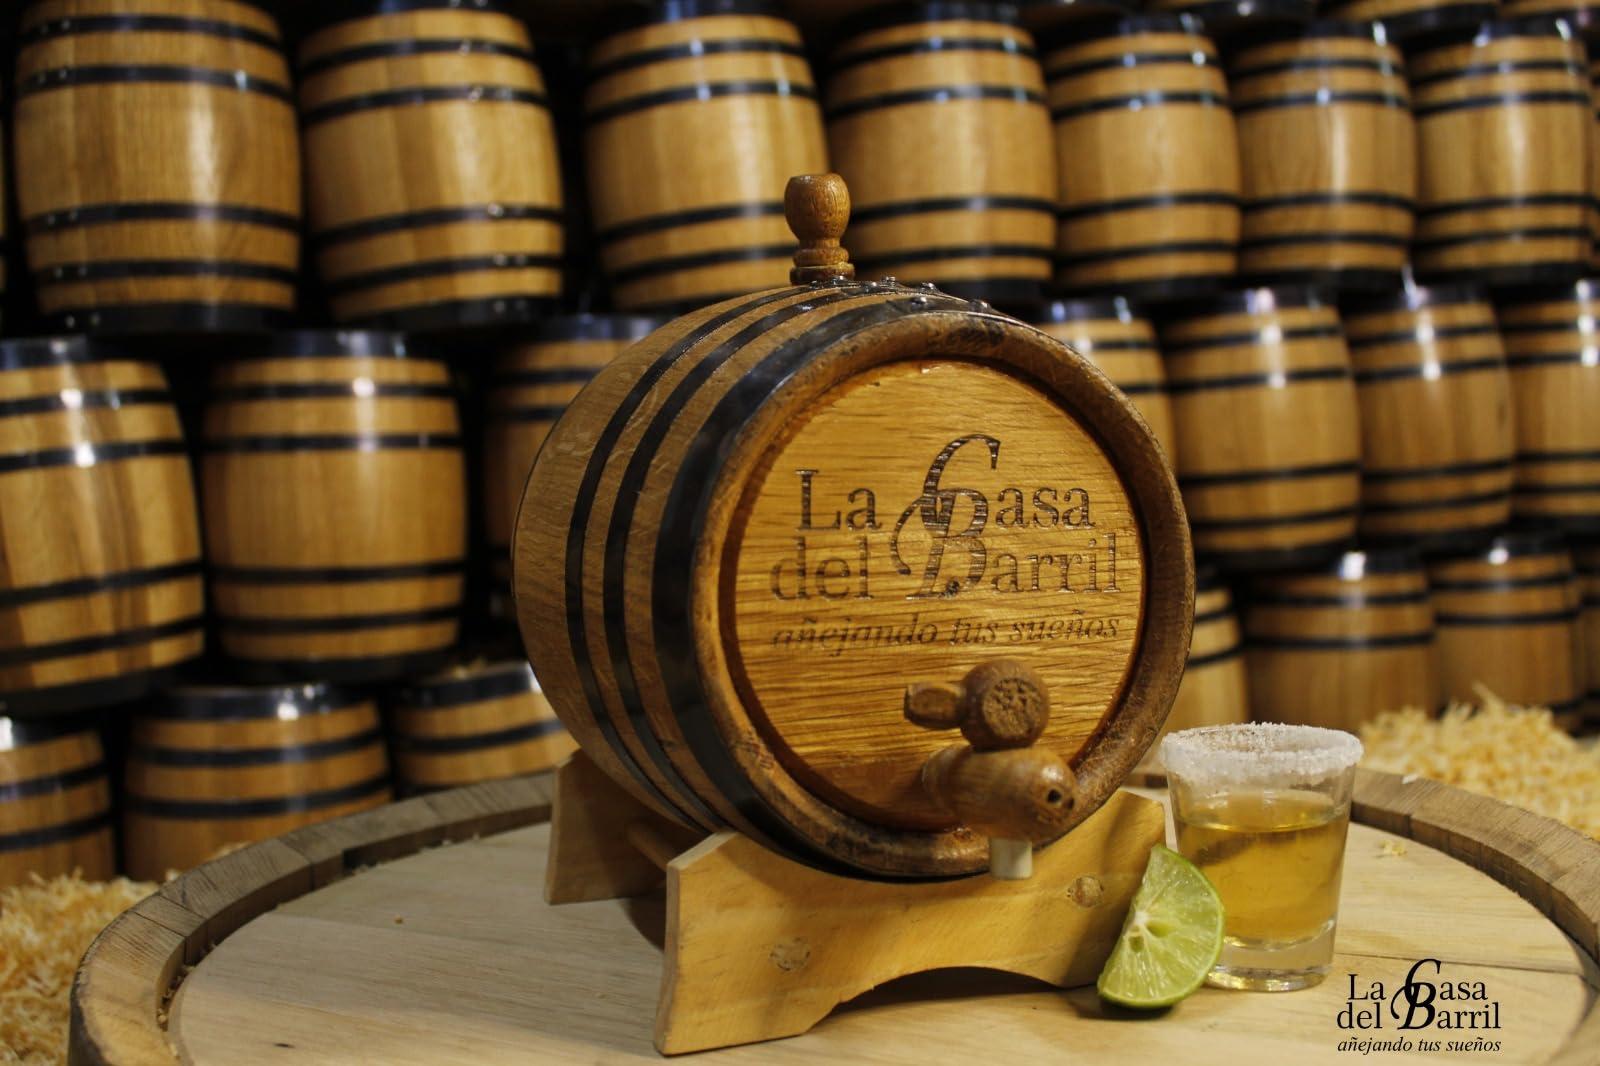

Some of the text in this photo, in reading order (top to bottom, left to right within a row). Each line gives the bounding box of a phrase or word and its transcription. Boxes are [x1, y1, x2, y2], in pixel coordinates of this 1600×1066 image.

[795, 469, 883, 531] La
[770, 487, 1121, 600] del Barril
[773, 608, 1121, 657] añejando tus sueños
